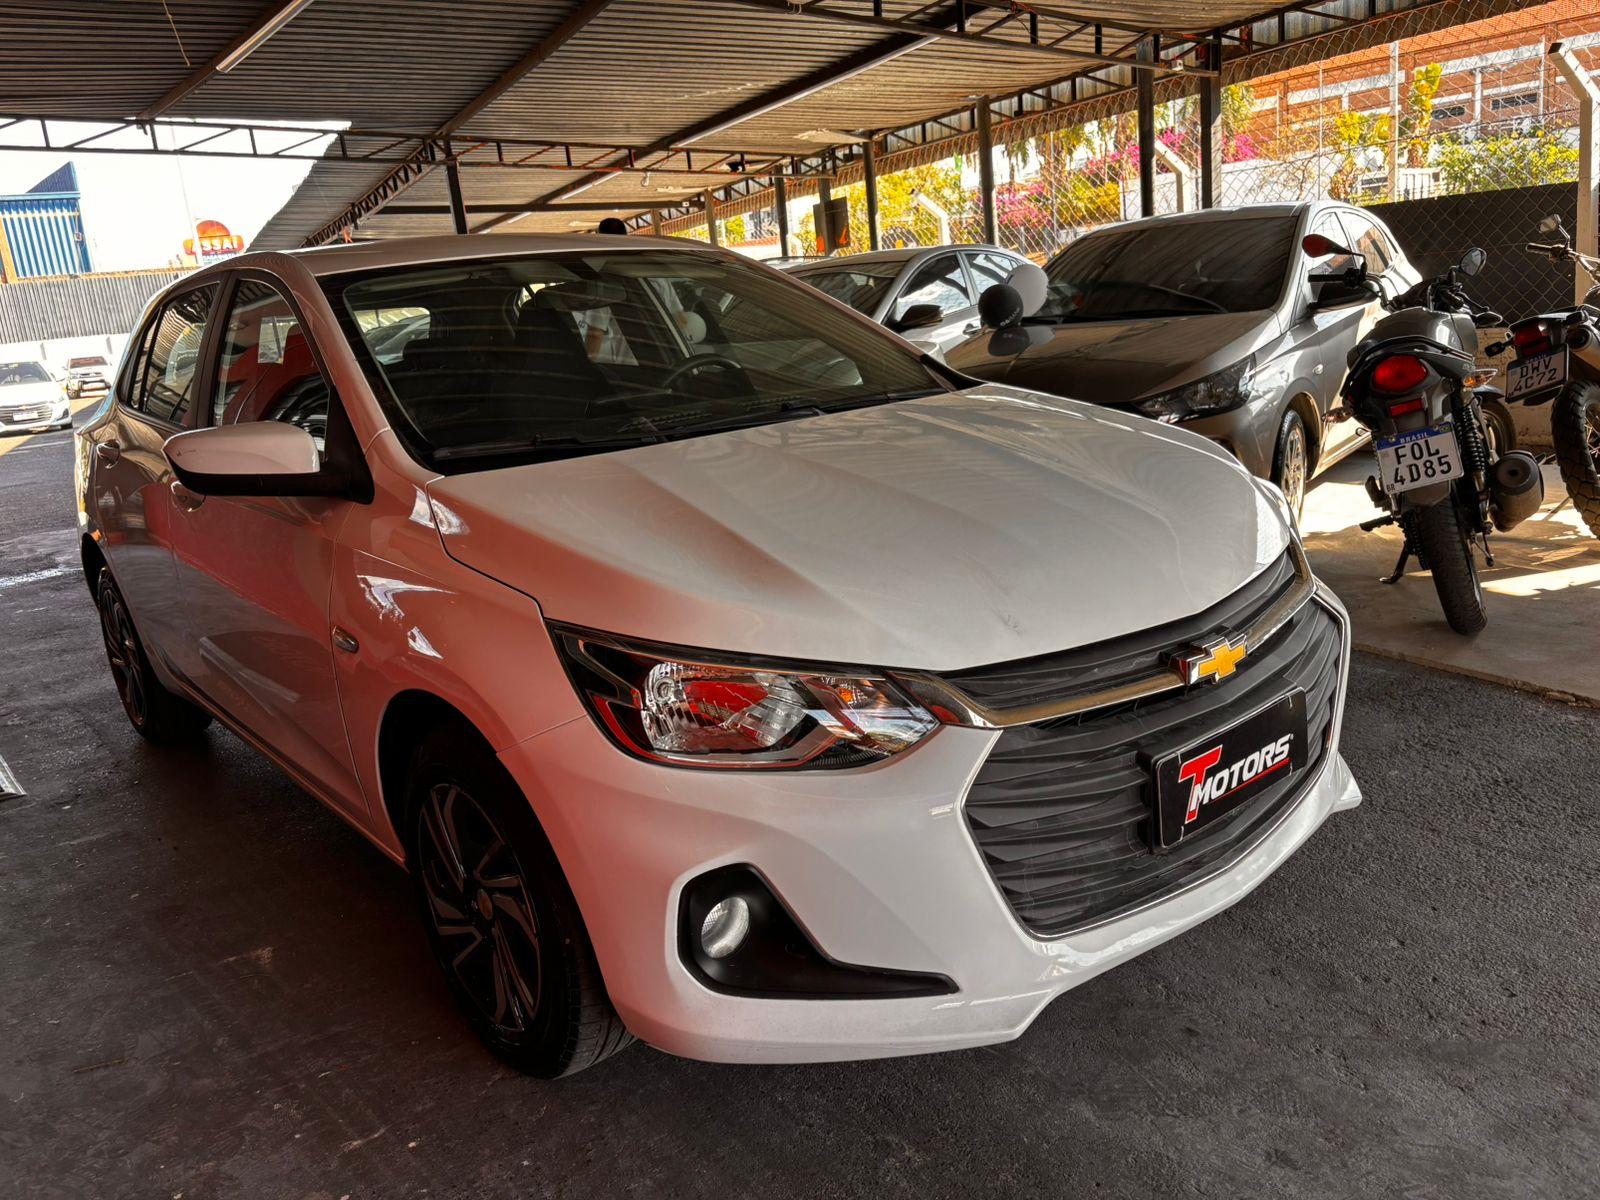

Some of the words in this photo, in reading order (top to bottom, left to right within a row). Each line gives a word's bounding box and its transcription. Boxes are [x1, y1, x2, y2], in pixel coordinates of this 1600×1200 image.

[1514, 368, 1557, 392] 4C72
[1400, 432, 1430, 444] BRASIL
[1394, 439, 1440, 465] FOL
[1394, 455, 1452, 485] 4D85
